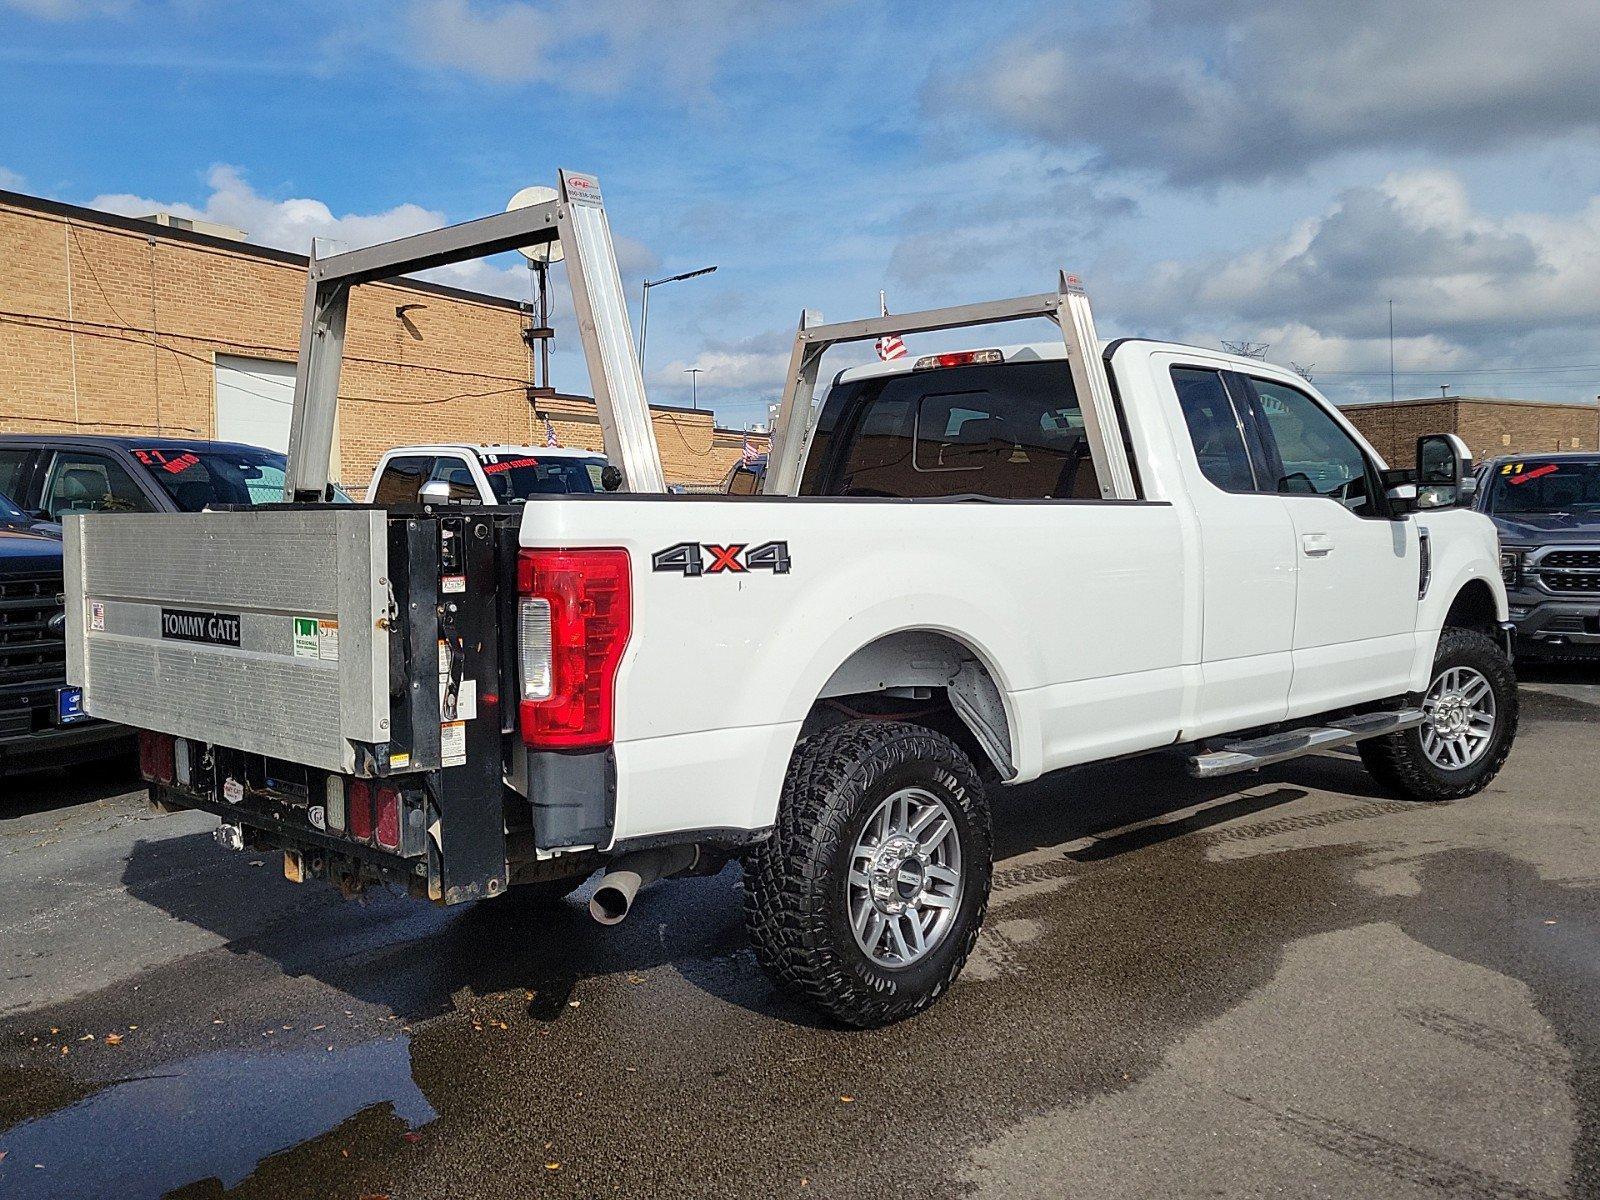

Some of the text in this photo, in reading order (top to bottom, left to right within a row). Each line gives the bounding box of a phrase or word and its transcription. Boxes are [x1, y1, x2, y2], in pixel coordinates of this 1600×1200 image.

[135, 450, 166, 464] 21
[479, 454, 498, 464] 18
[1500, 463, 1524, 475] 21
[163, 613, 239, 641] TOMMY GATE
